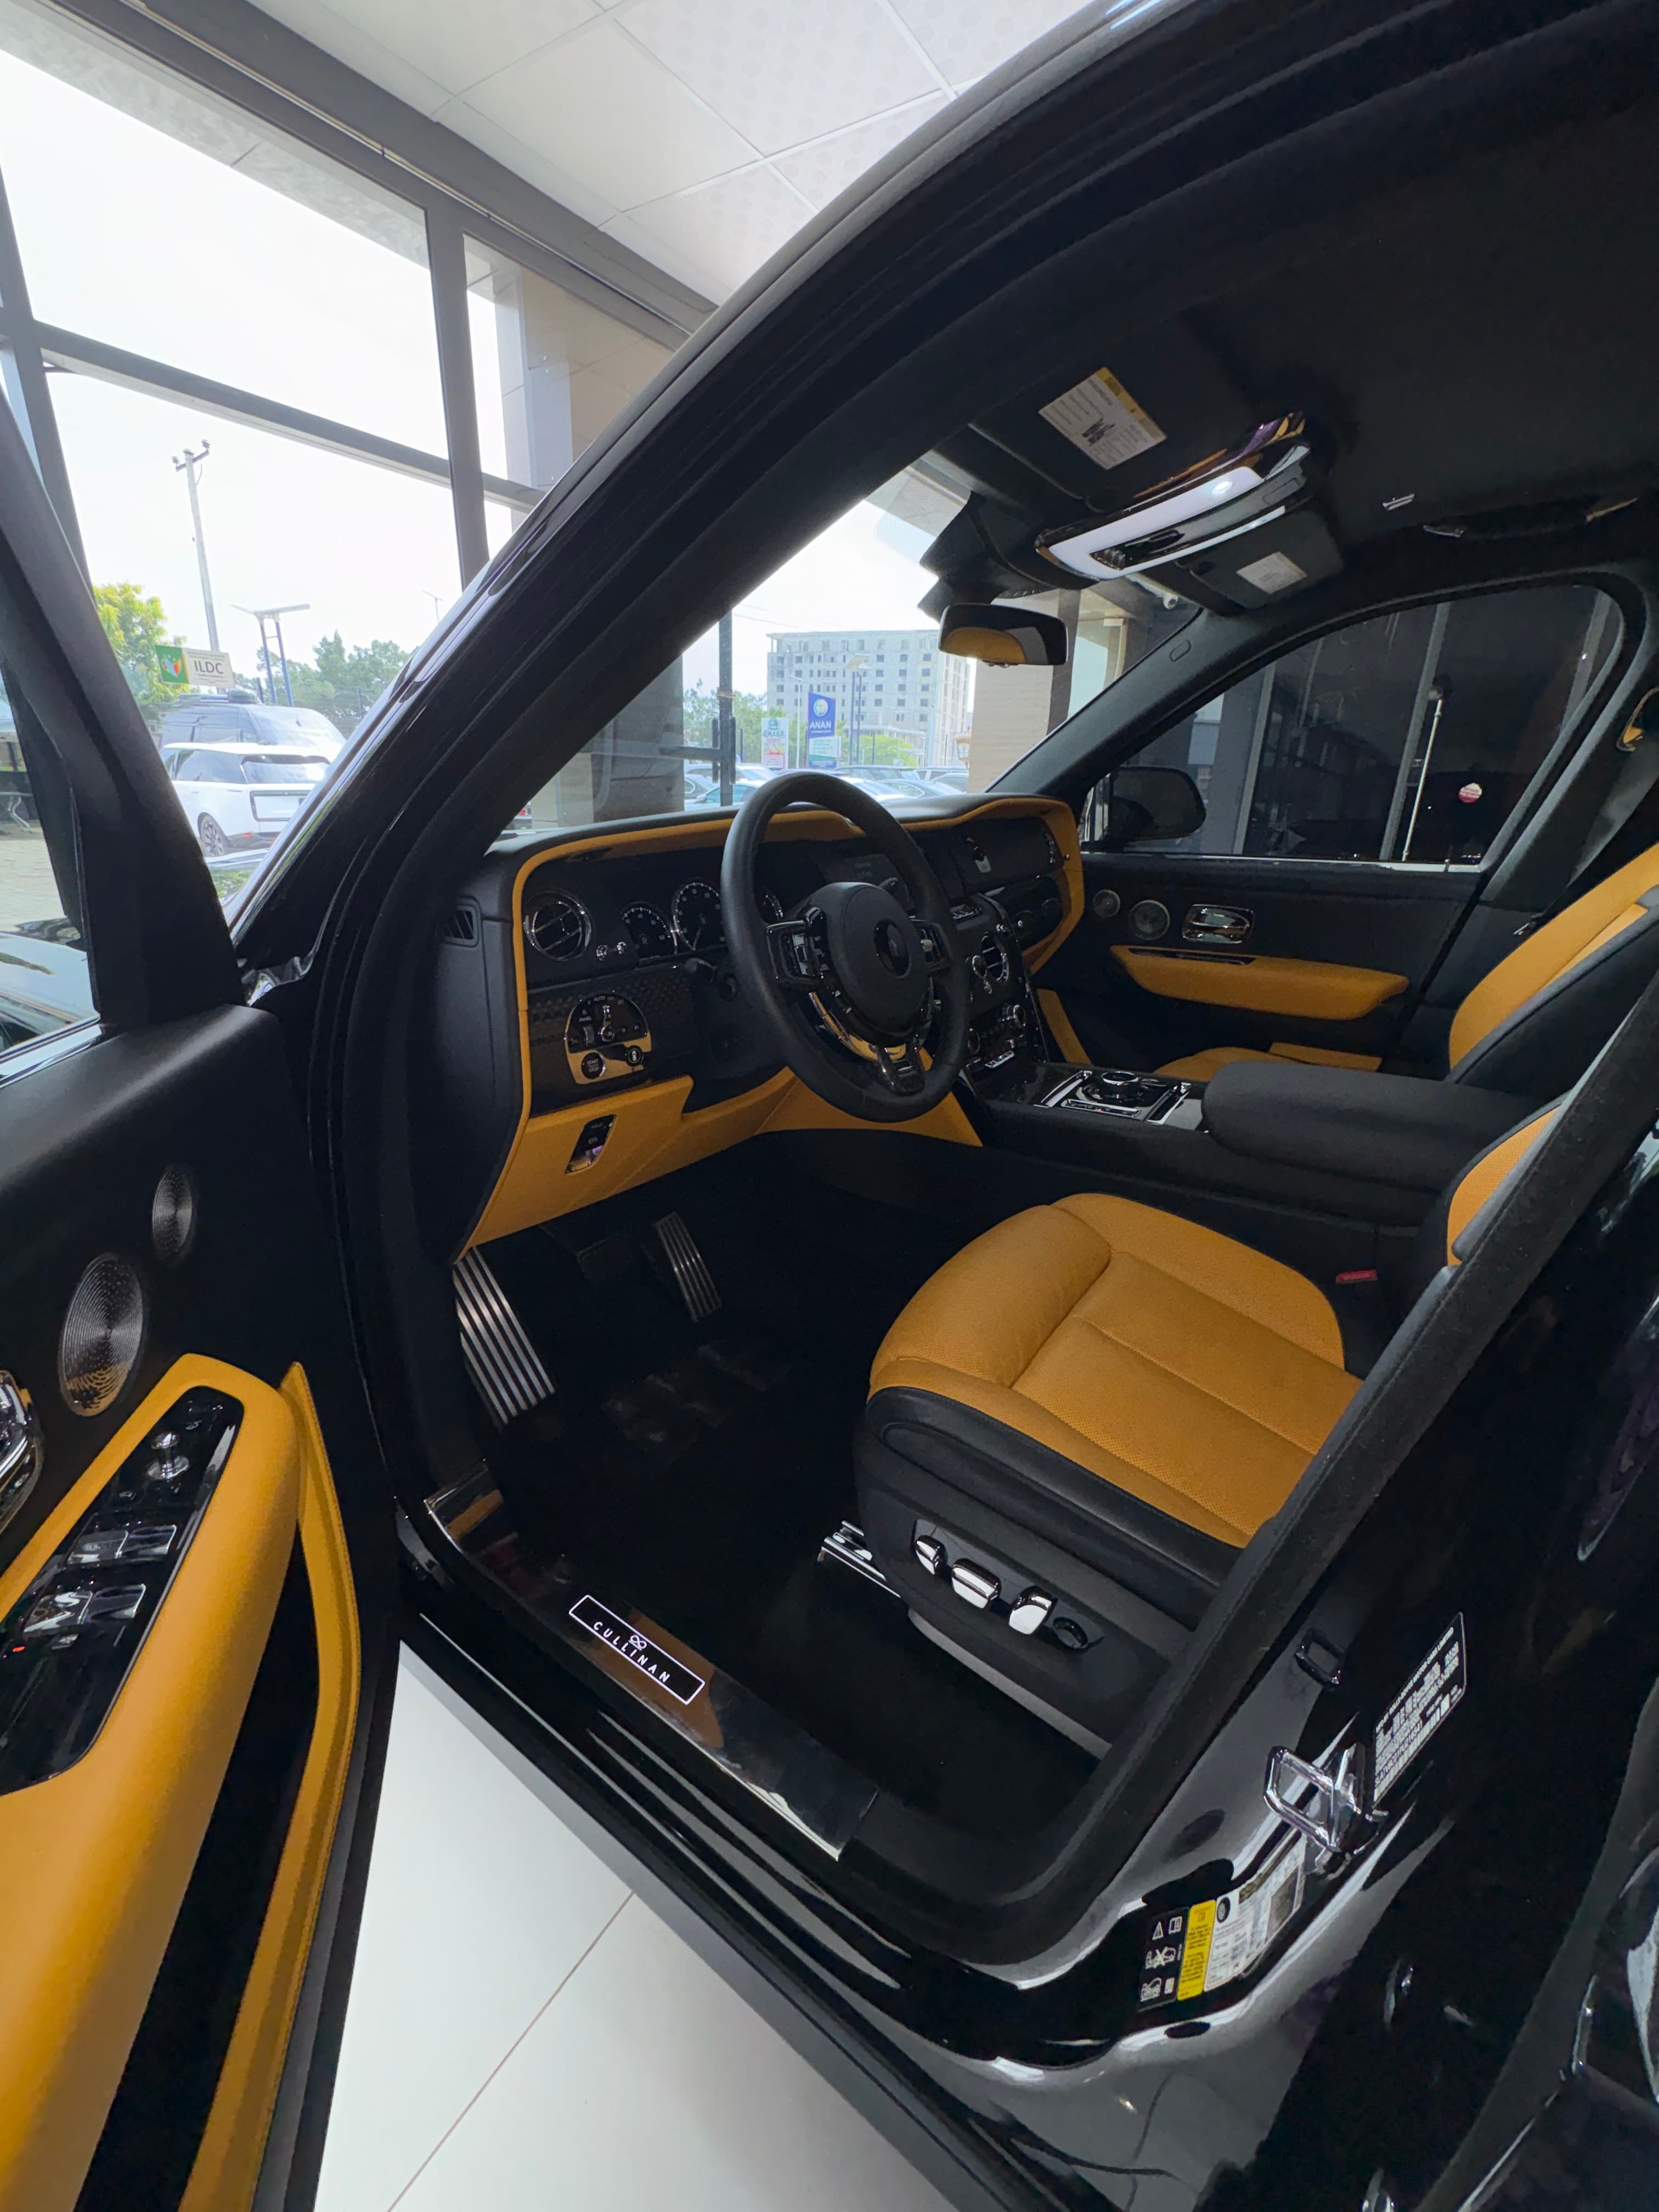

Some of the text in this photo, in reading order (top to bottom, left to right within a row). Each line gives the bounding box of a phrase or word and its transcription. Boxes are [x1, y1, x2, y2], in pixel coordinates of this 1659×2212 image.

[194, 660, 224, 674] ILDC
[810, 721, 832, 729] ANAN
[593, 1621, 670, 1684] CULLINAN
